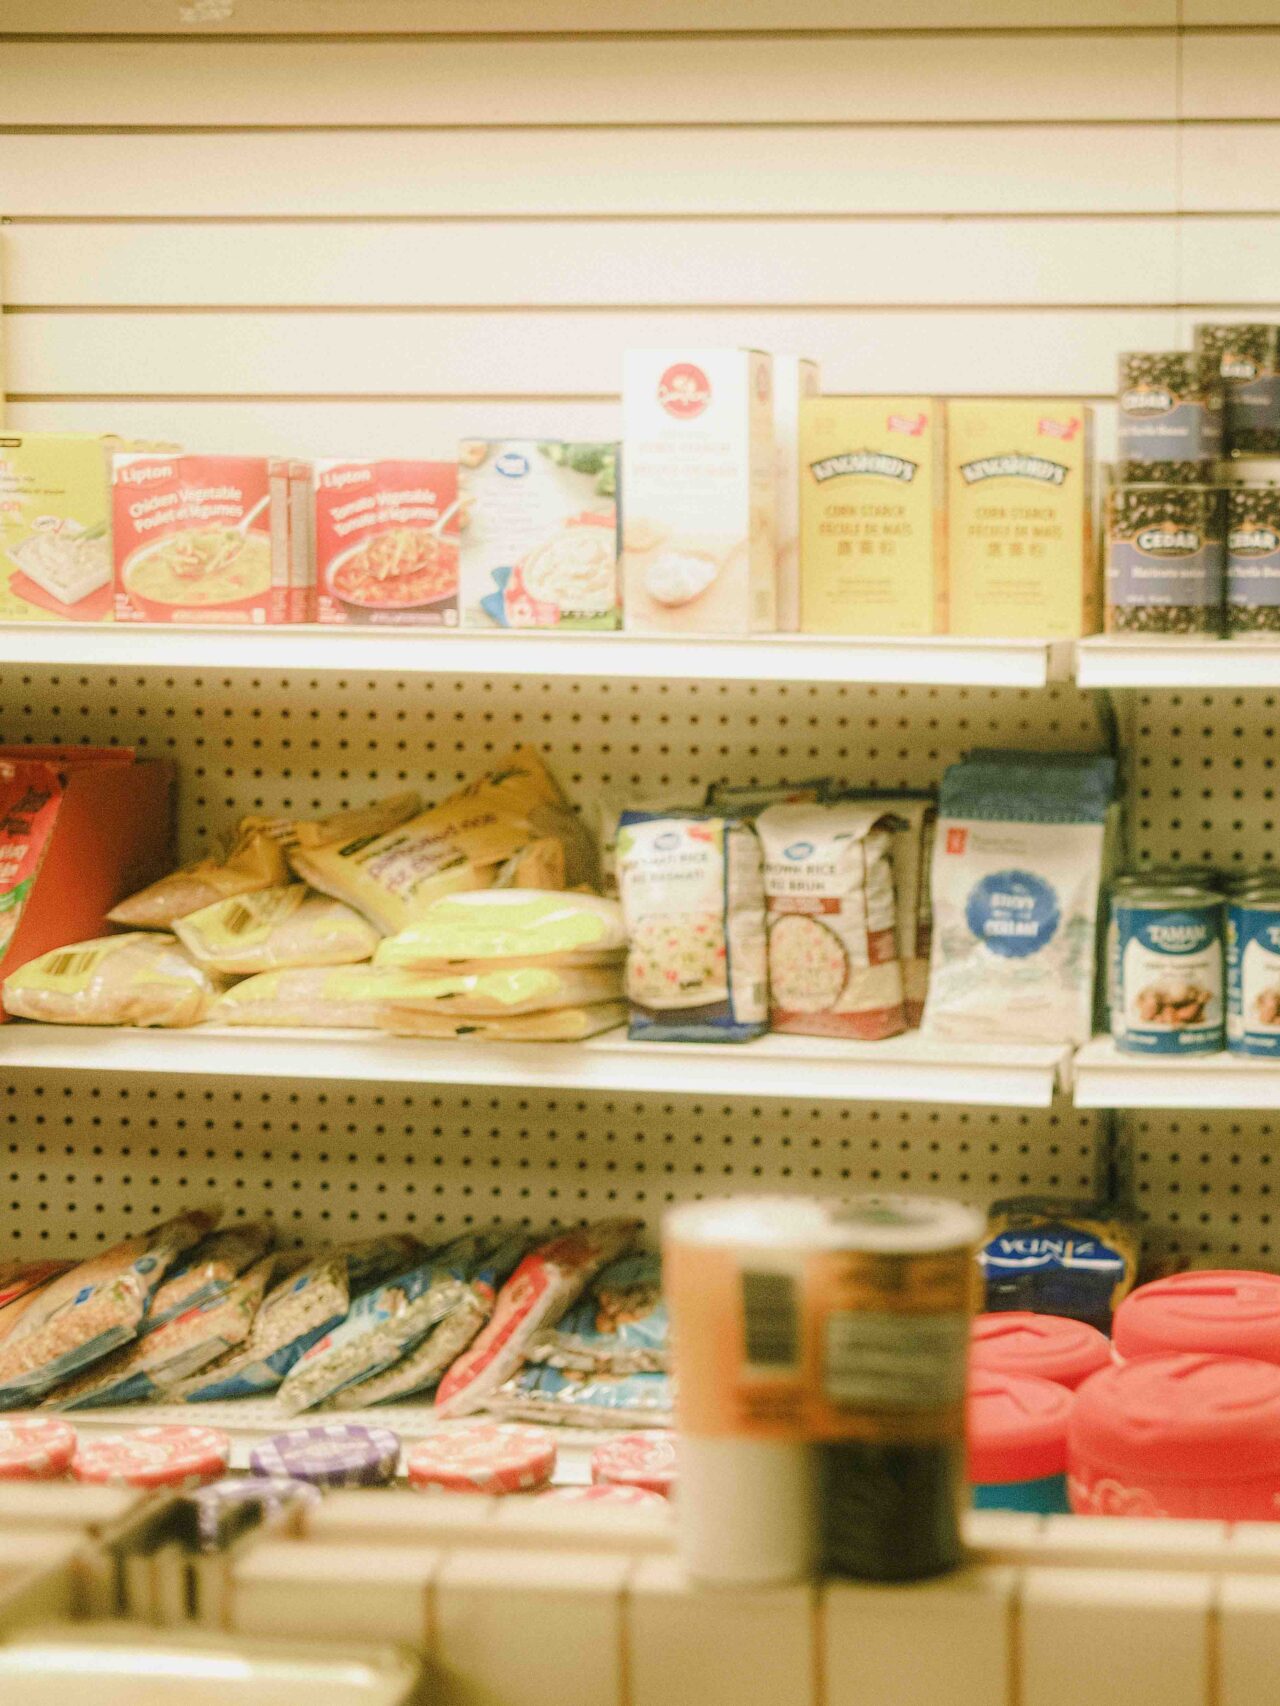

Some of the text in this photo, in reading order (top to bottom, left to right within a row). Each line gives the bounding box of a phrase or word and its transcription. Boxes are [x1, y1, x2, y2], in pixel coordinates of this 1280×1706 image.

[122, 465, 173, 485] Lipton
[324, 470, 372, 489] Lipton
[1139, 532, 1199, 550] CEDAR
